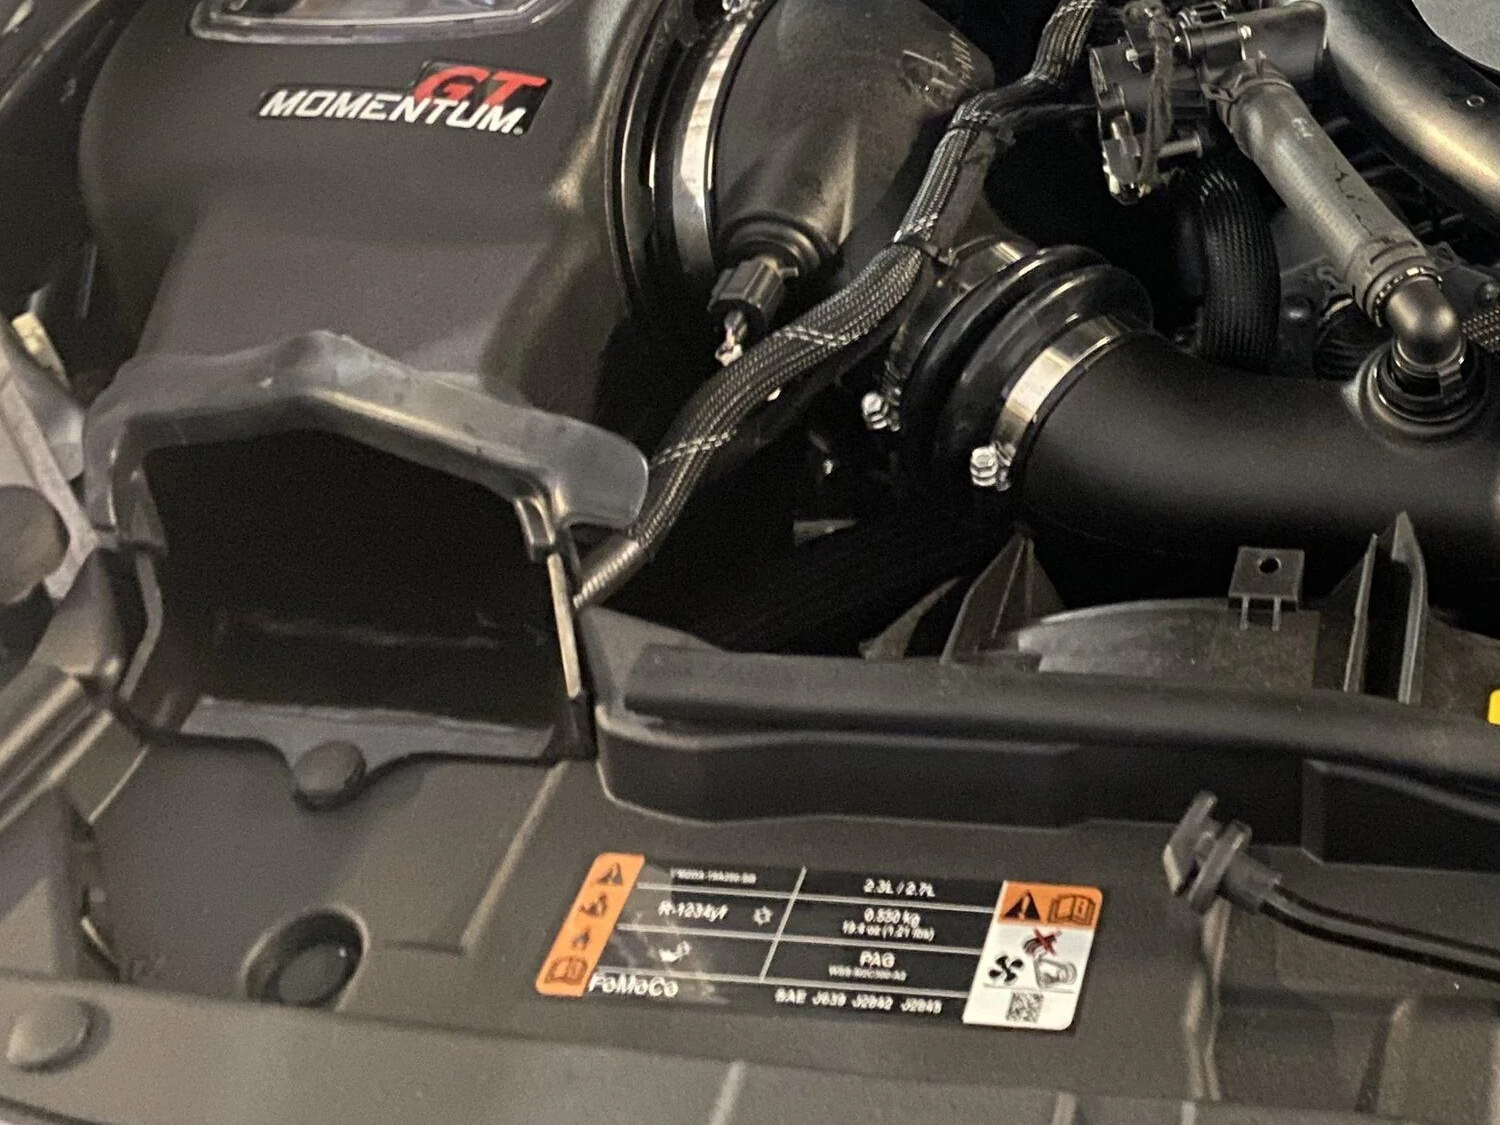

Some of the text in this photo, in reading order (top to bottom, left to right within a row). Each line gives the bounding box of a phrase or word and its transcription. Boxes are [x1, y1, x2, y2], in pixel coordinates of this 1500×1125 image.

[412, 66, 549, 106] GT
[259, 90, 527, 134] MOMENTUM
[863, 878, 893, 894] 2.3L
[905, 881, 936, 897] 2.7L
[902, 910, 921, 928] kg
[860, 950, 895, 968] PAG
[589, 972, 679, 998] FoMoCo
[775, 988, 807, 1004] SAE
